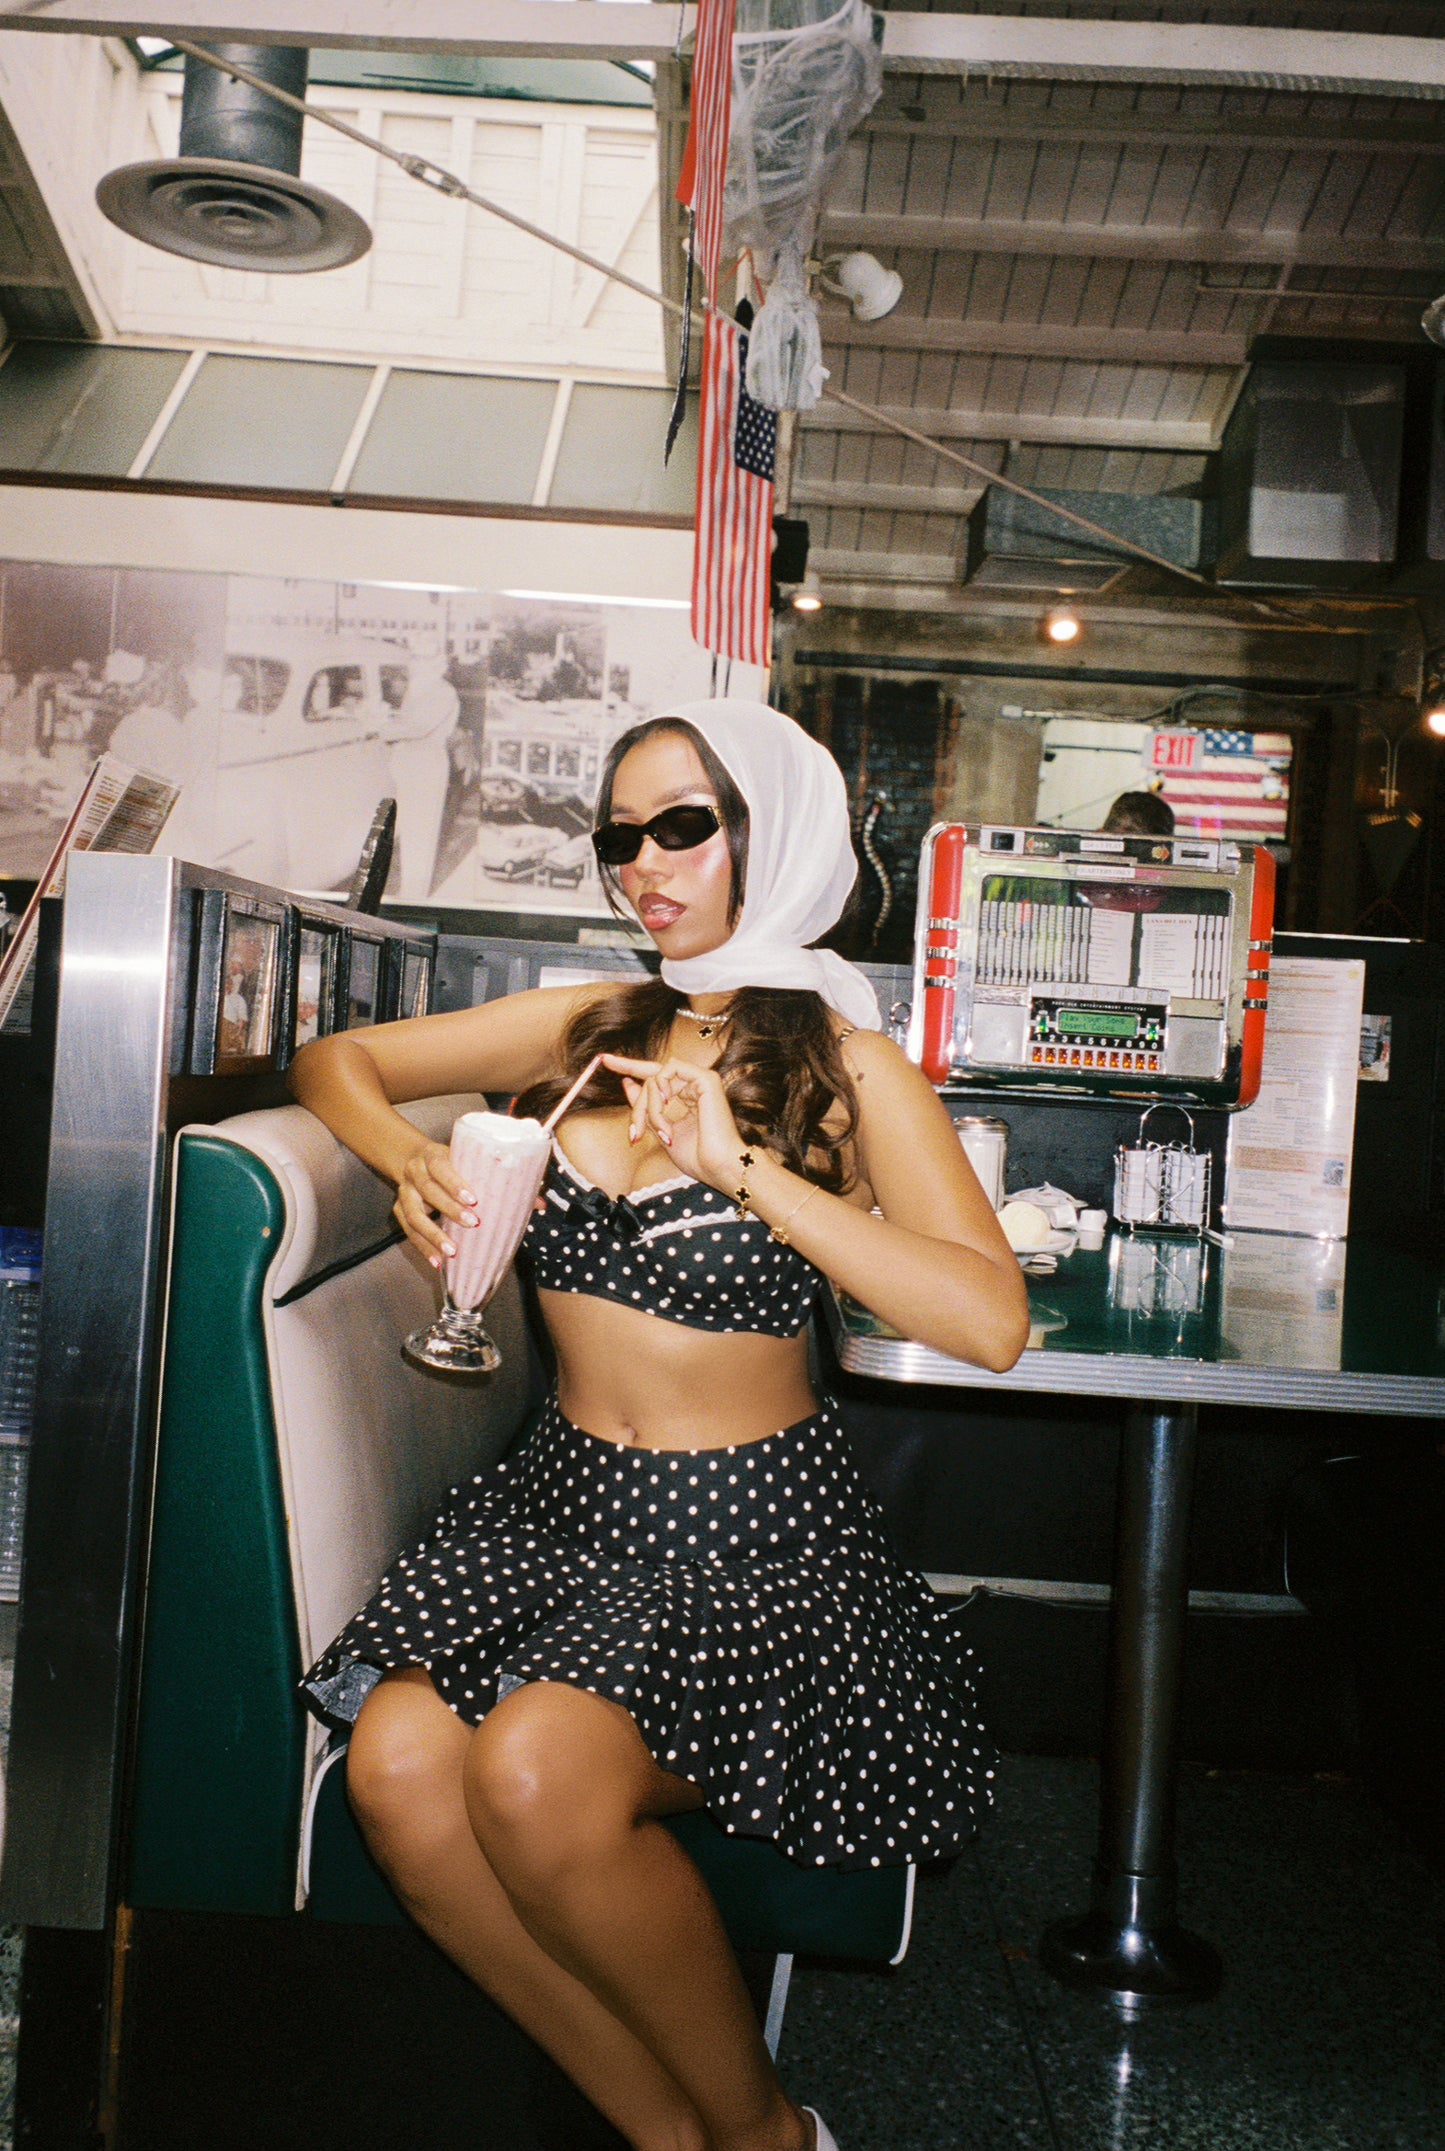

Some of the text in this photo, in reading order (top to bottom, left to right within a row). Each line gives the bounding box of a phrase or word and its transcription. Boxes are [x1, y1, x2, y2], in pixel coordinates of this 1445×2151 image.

[1152, 733, 1198, 767] EXIT
[1049, 1034, 1055, 1042] 2
[1062, 1035, 1068, 1043] 3
[1075, 1036, 1081, 1044] 4
[1088, 1037, 1094, 1045] 5
[1100, 1038, 1107, 1046] 6
[1113, 1039, 1120, 1047] 7
[1126, 1040, 1133, 1048] 8
